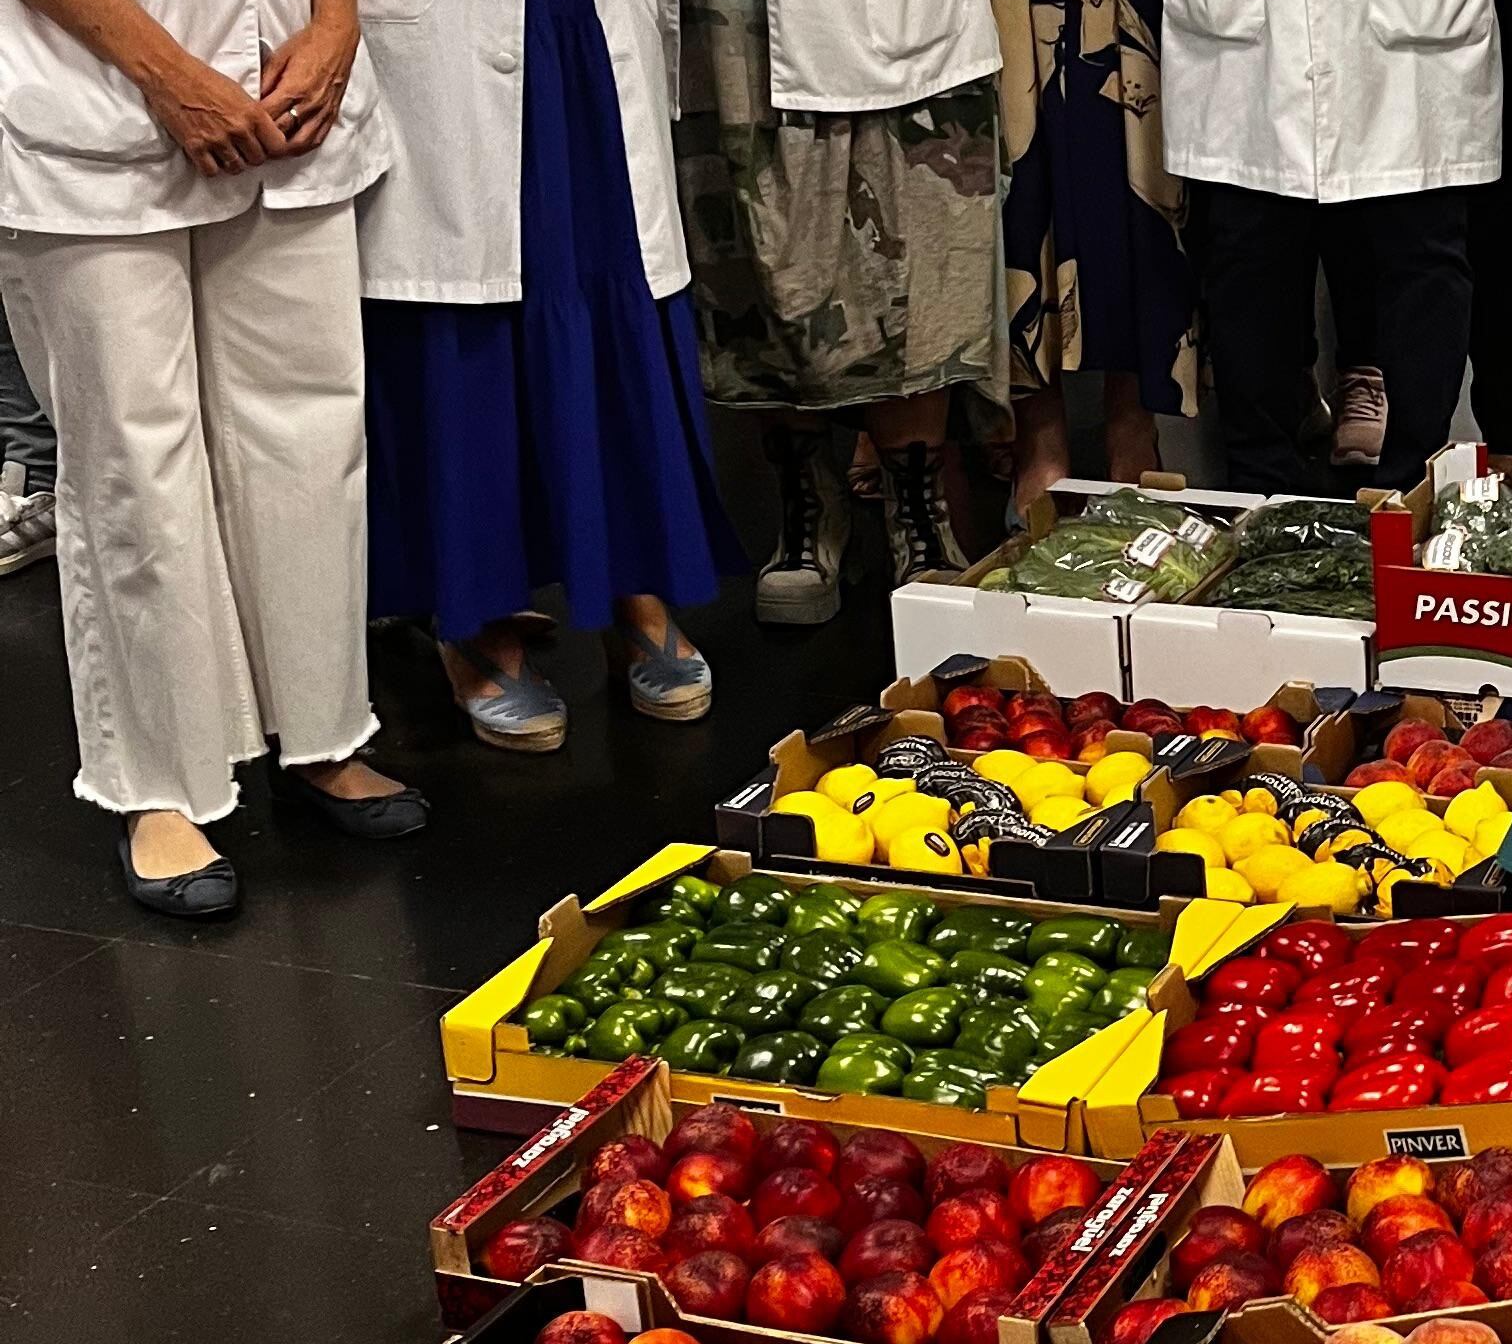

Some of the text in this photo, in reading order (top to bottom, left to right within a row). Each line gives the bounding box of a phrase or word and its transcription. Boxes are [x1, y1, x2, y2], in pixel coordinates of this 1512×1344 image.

[512, 1106, 590, 1169] zaragüel
[1391, 1134, 1461, 1154] PINVER
[1070, 1186, 1135, 1252] zaragüel
[1108, 1192, 1170, 1258] zaragüel
